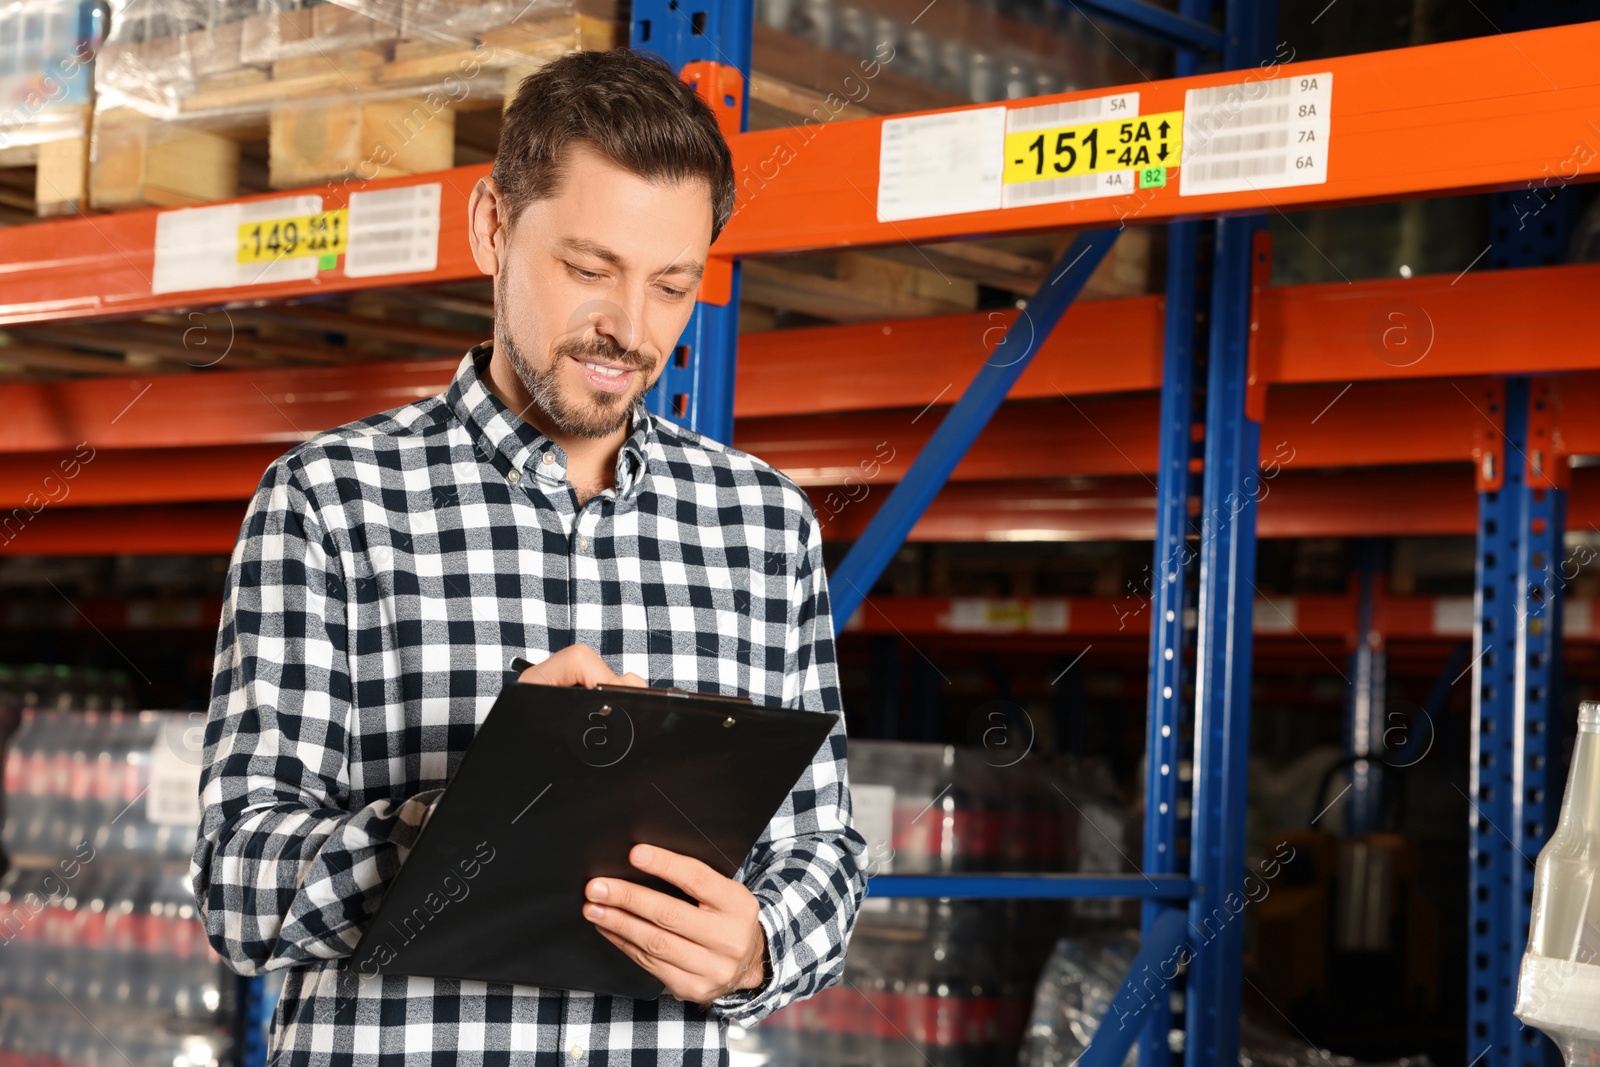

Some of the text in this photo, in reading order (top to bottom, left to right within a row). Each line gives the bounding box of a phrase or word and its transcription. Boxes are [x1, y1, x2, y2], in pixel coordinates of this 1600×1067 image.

[1300, 78, 1318, 91] 9A
[1110, 97, 1126, 111] 5A
[1298, 105, 1316, 118] 8A
[1119, 121, 1152, 144] 5A
[1298, 130, 1315, 143] 7A
[1296, 156, 1314, 169] 6A
[1106, 173, 1122, 187] 4A
